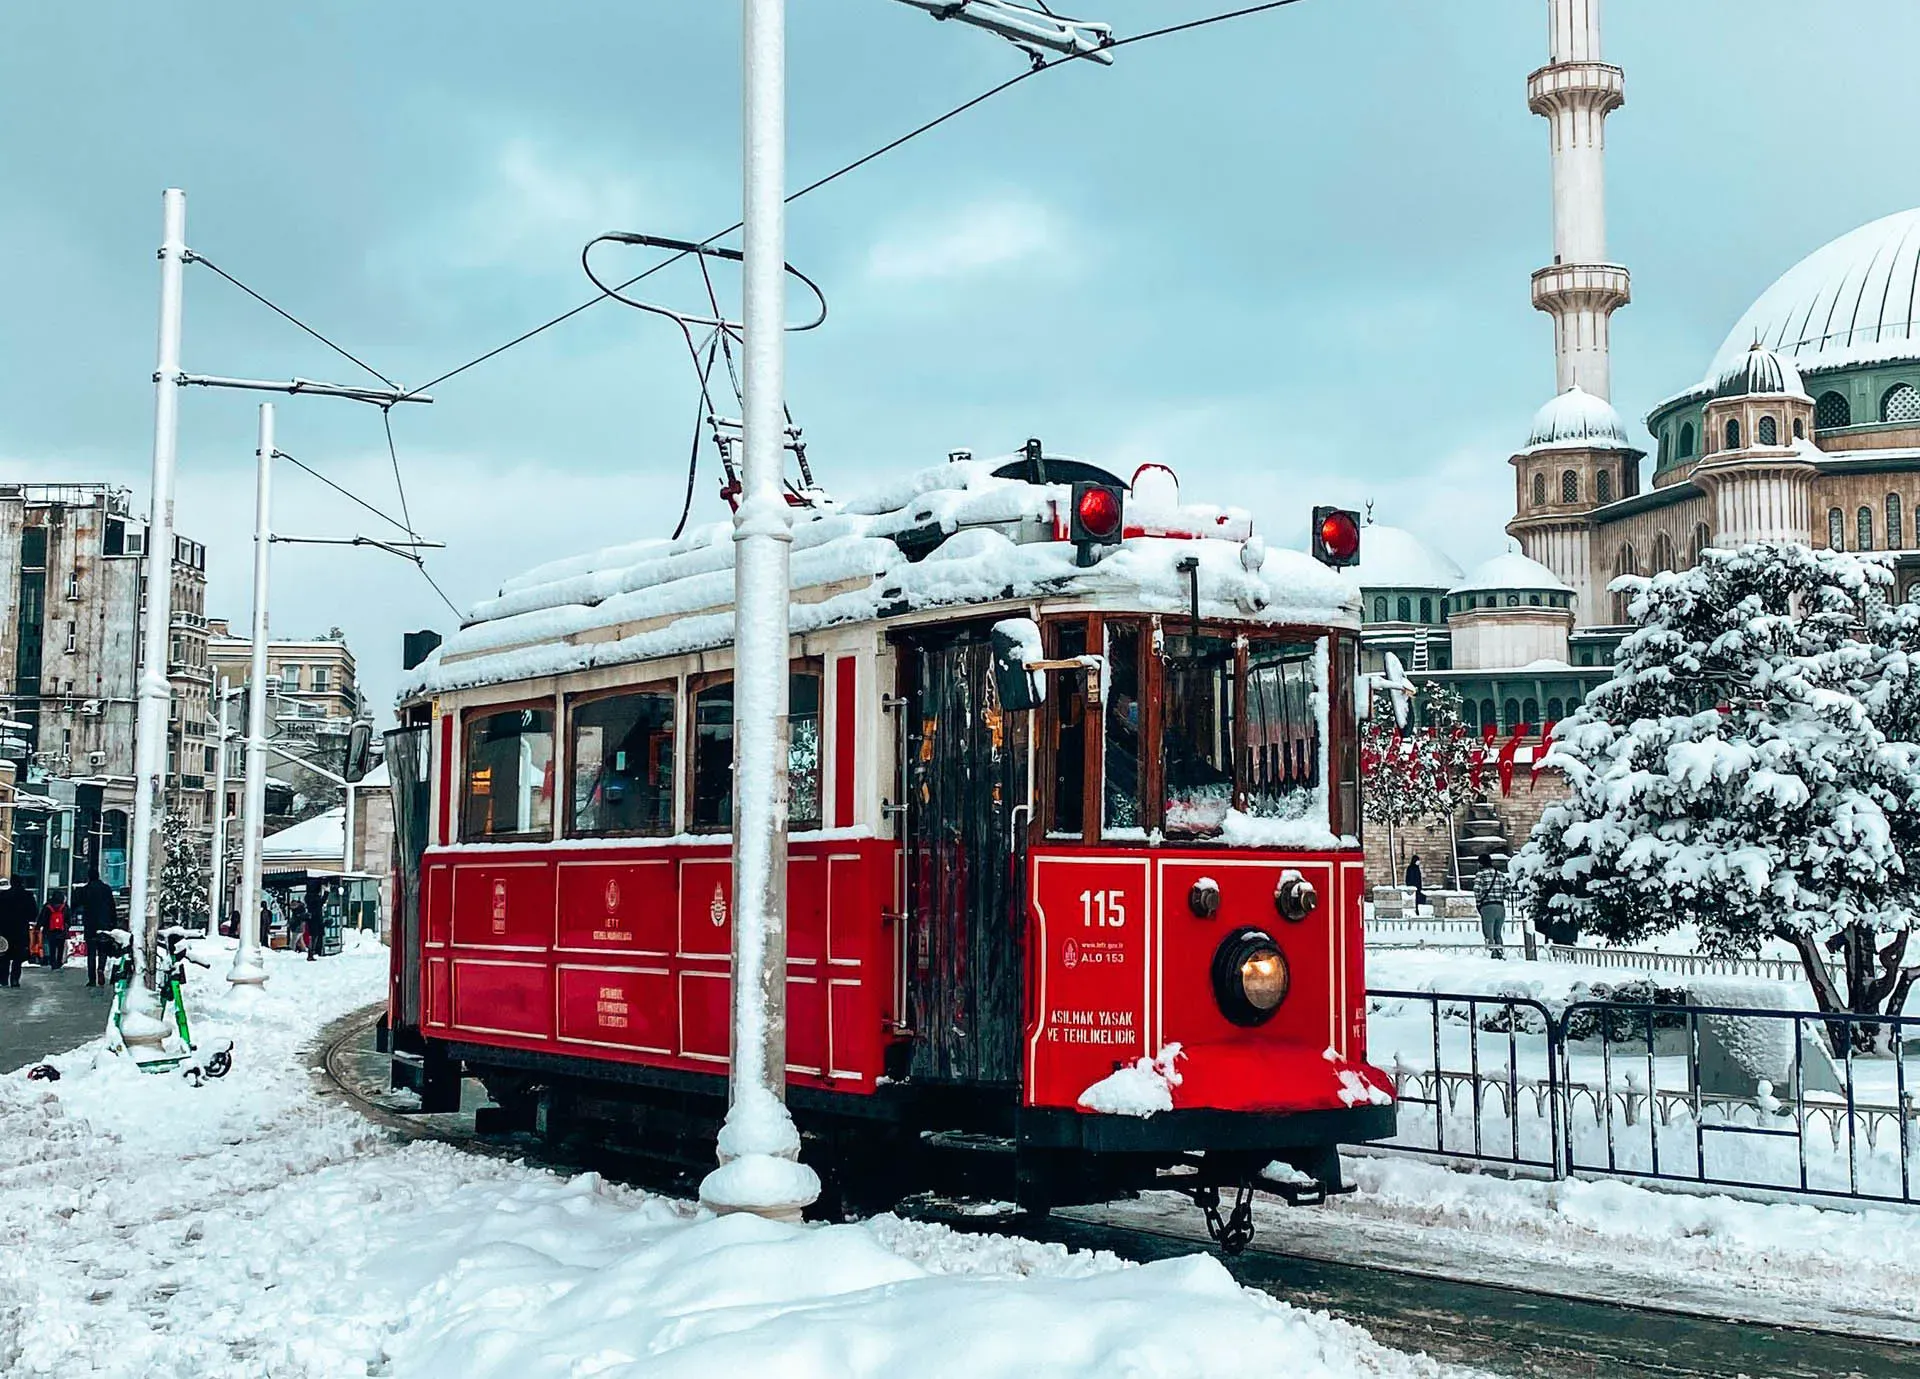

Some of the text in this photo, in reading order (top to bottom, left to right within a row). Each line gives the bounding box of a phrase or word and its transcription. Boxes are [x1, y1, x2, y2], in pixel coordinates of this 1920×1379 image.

[1080, 890, 1124, 927] 115
[1081, 953, 1124, 963] ALO 153
[1051, 1010, 1133, 1026] ASILMAK YASAK
[1047, 1027, 1059, 1042] VE
